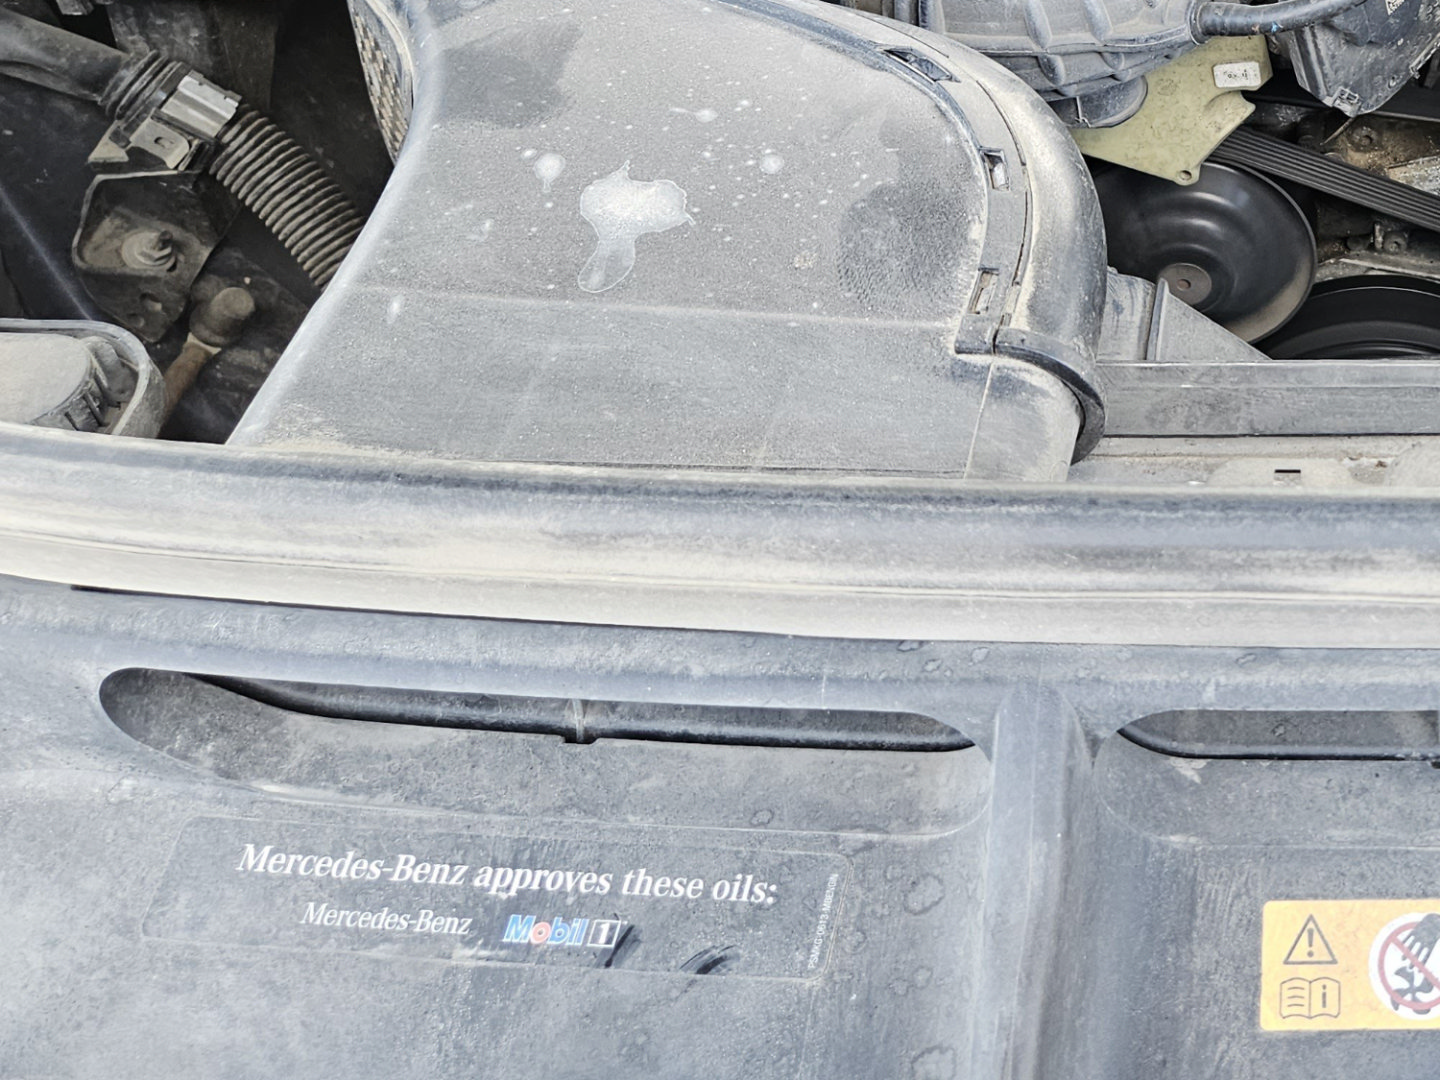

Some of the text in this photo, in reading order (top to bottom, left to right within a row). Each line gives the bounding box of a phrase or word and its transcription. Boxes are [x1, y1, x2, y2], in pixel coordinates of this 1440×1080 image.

[235, 843, 778, 905] Mercedes-Benz approves these oils:
[299, 901, 473, 936] Mercedes-Benz
[502, 914, 590, 946] Mobil
